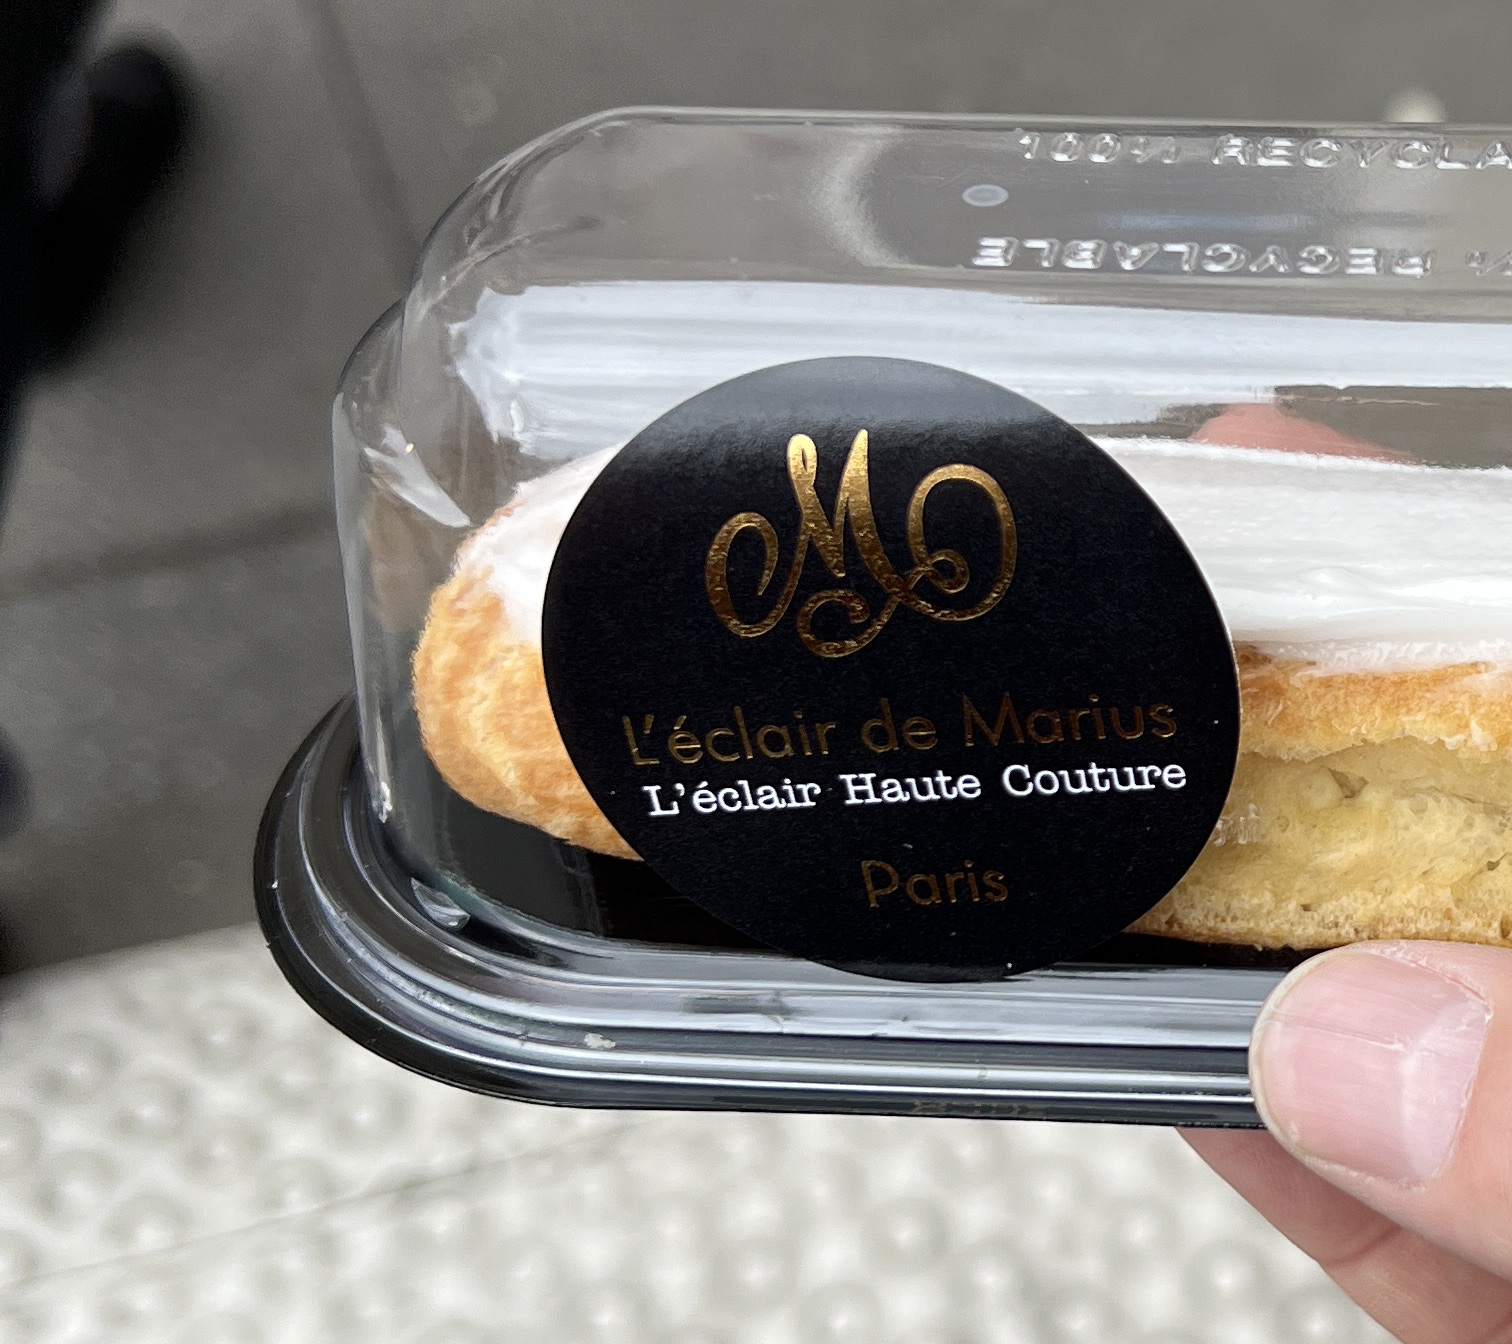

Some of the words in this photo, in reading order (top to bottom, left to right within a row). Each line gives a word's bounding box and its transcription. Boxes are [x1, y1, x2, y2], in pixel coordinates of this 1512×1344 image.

[970, 236, 1436, 279] RECYCLABLE
[621, 706, 837, 767] L'éclair
[860, 697, 938, 755] de
[961, 692, 1179, 748] Marius
[643, 778, 822, 818] L'éclair
[838, 770, 983, 806] Haute
[1001, 761, 1188, 798] Couture
[859, 858, 1010, 909] Paris
